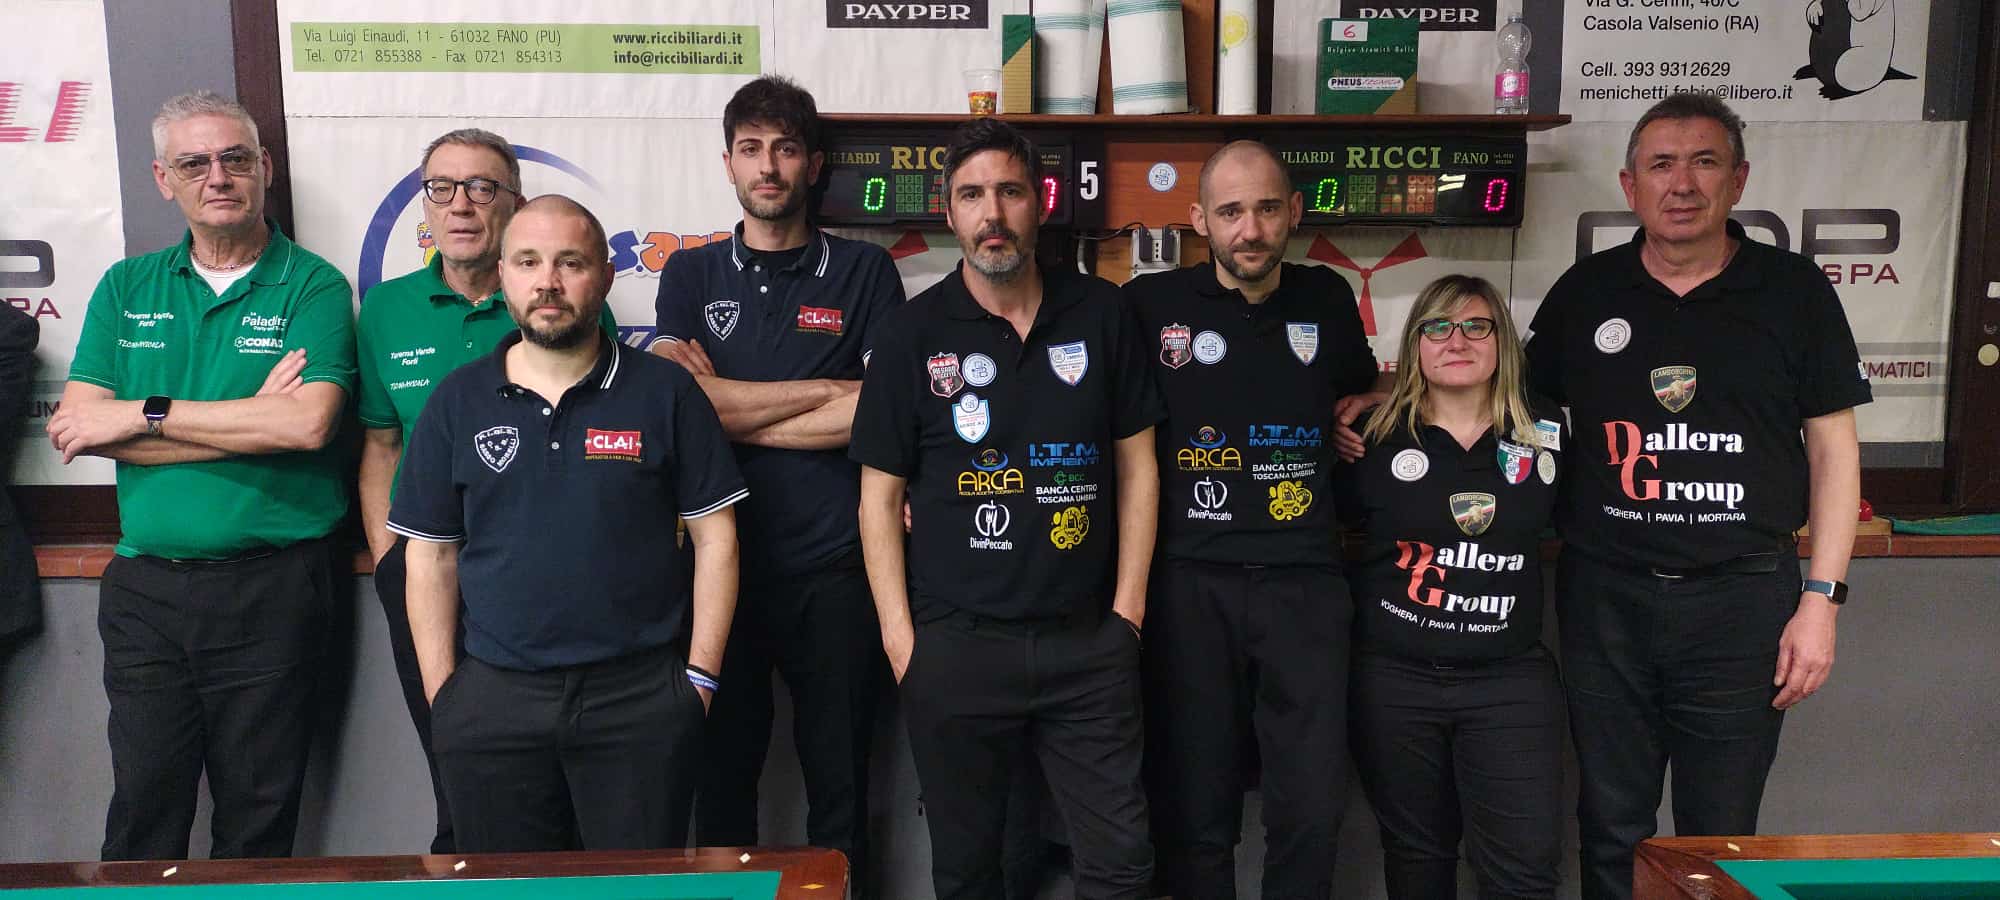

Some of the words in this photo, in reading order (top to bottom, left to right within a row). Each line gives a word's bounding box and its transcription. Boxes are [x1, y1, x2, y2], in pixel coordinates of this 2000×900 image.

[845, 4, 971, 20] PAYPER
[1359, 8, 1480, 23] PAYPER
[1343, 24, 1356, 38] 6
[1583, 16, 1643, 31] Casola
[1648, 16, 1719, 31] Valsenio
[1724, 15, 1759, 33] (RA)
[304, 29, 322, 43] Via
[329, 29, 357, 45] Luigi
[363, 29, 410, 45] Einaudi,
[417, 29, 430, 43] 11
[450, 29, 489, 43] 61032
[497, 30, 528, 43] FANO
[535, 29, 561, 46] (PU)
[613, 32, 742, 45] www.riccibiliardi.it
[304, 49, 325, 63] Tel.
[334, 50, 364, 63] 0721
[375, 50, 422, 63] 855388
[446, 50, 466, 63] Fax
[475, 50, 505, 63] 0721
[516, 50, 562, 63] 854313
[614, 51, 743, 66] info@riccibiliardi.it
[1581, 62, 1617, 77] Cell.
[1623, 62, 1655, 77] 393
[1660, 62, 1731, 77] 9312629
[891, 147, 945, 169] RIC
[1281, 151, 1335, 164] ILIARDI
[1346, 146, 1442, 169] RICCI
[1453, 152, 1489, 165] FANO
[1080, 161, 1099, 200] 5
[864, 177, 886, 211] 0
[1316, 178, 1338, 211] 0
[1484, 179, 1509, 211] 0
[1822, 263, 1900, 285] SPA
[804, 311, 836, 324] CLAI
[1863, 361, 1931, 379] MATICI
[593, 434, 634, 450] CLAI
[1602, 420, 1745, 465] Dallera
[1177, 448, 1242, 467] ARCA
[1252, 464, 1285, 472] BANCA
[1252, 472, 1290, 480] TOSCANA
[957, 468, 1024, 491] ARCA
[1620, 454, 1745, 510] Group
[1035, 486, 1069, 495] BANCA
[1036, 495, 1075, 504] TOSCANA
[1603, 504, 1643, 521] VOGHERA
[1655, 513, 1685, 523] PAVIA
[1698, 513, 1746, 523] MORTARA
[970, 537, 1013, 550] DivinPeccato
[1394, 540, 1524, 572] Dallera
[1407, 564, 1516, 621] Group
[1381, 598, 1418, 624] VOGHERA
[1428, 619, 1456, 630] PAVIA
